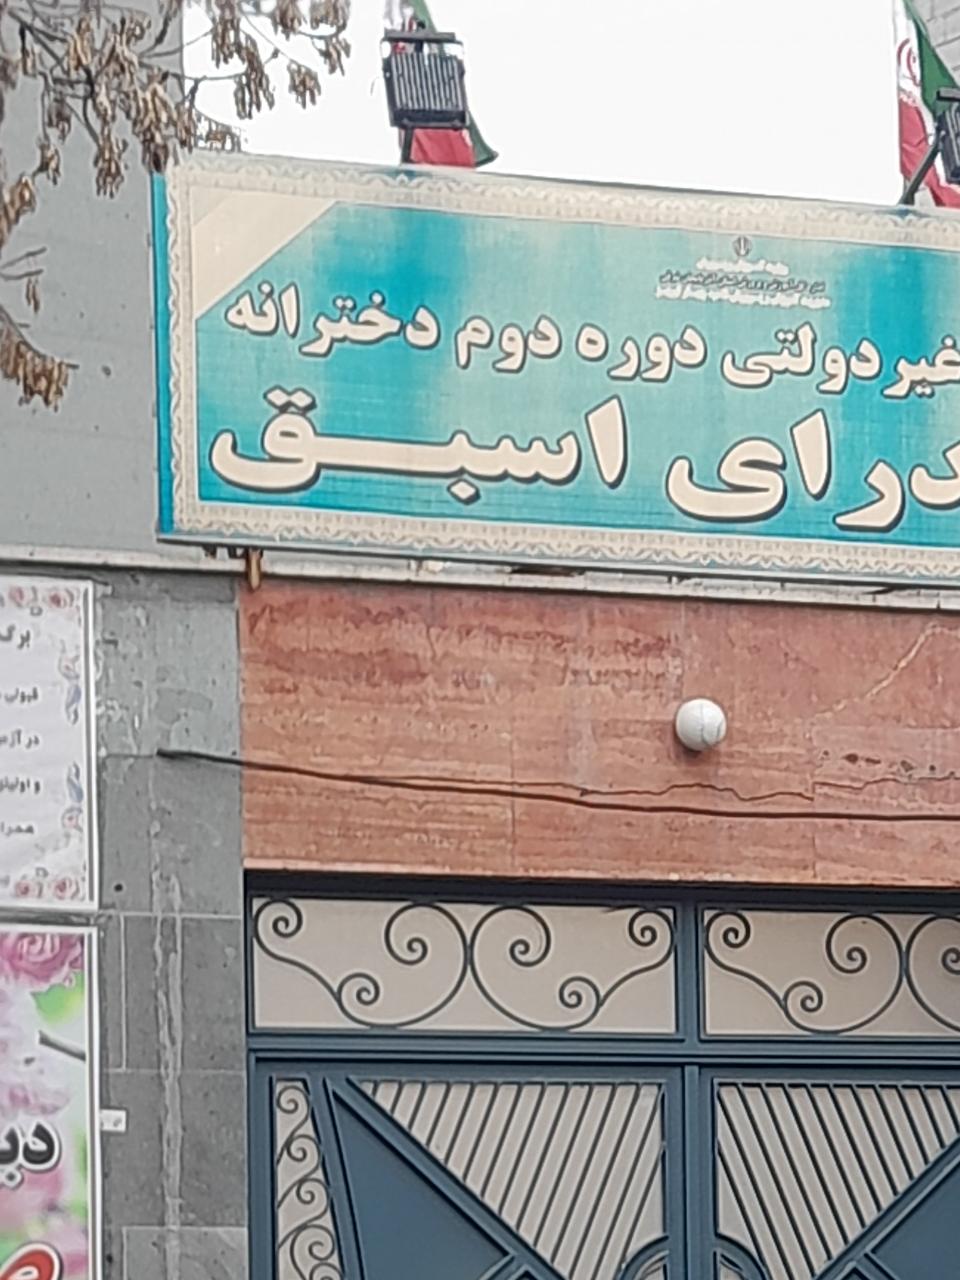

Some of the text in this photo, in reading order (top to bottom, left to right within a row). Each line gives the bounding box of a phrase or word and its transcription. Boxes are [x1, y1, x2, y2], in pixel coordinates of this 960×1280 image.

[226, 283, 439, 356] دخترانه
[457, 317, 560, 371] دوم
[576, 327, 706, 381] دوره
[210, 387, 626, 503] اسبق
